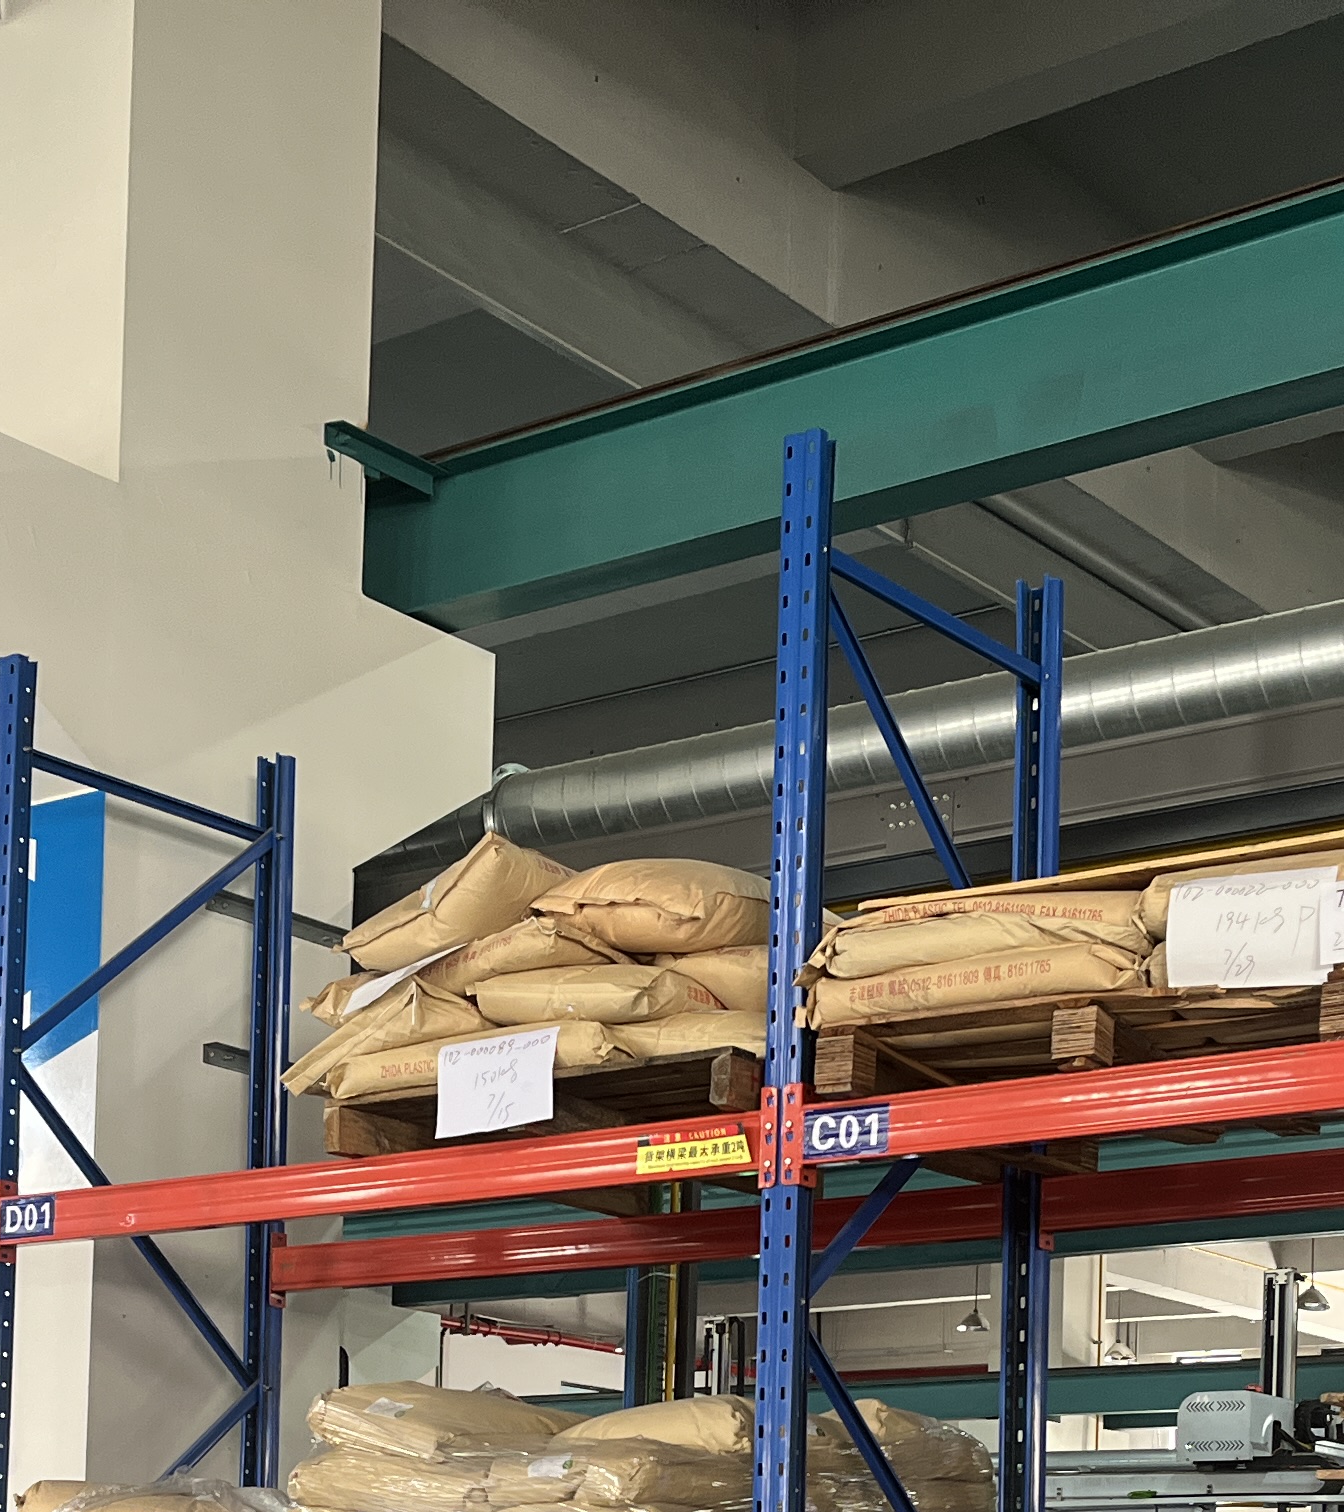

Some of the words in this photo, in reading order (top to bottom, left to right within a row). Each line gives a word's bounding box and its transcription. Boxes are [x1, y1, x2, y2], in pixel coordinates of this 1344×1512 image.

[688, 1127, 727, 1141] CAUTION
[810, 1112, 881, 1154] C01
[4, 1200, 53, 1234] D01
